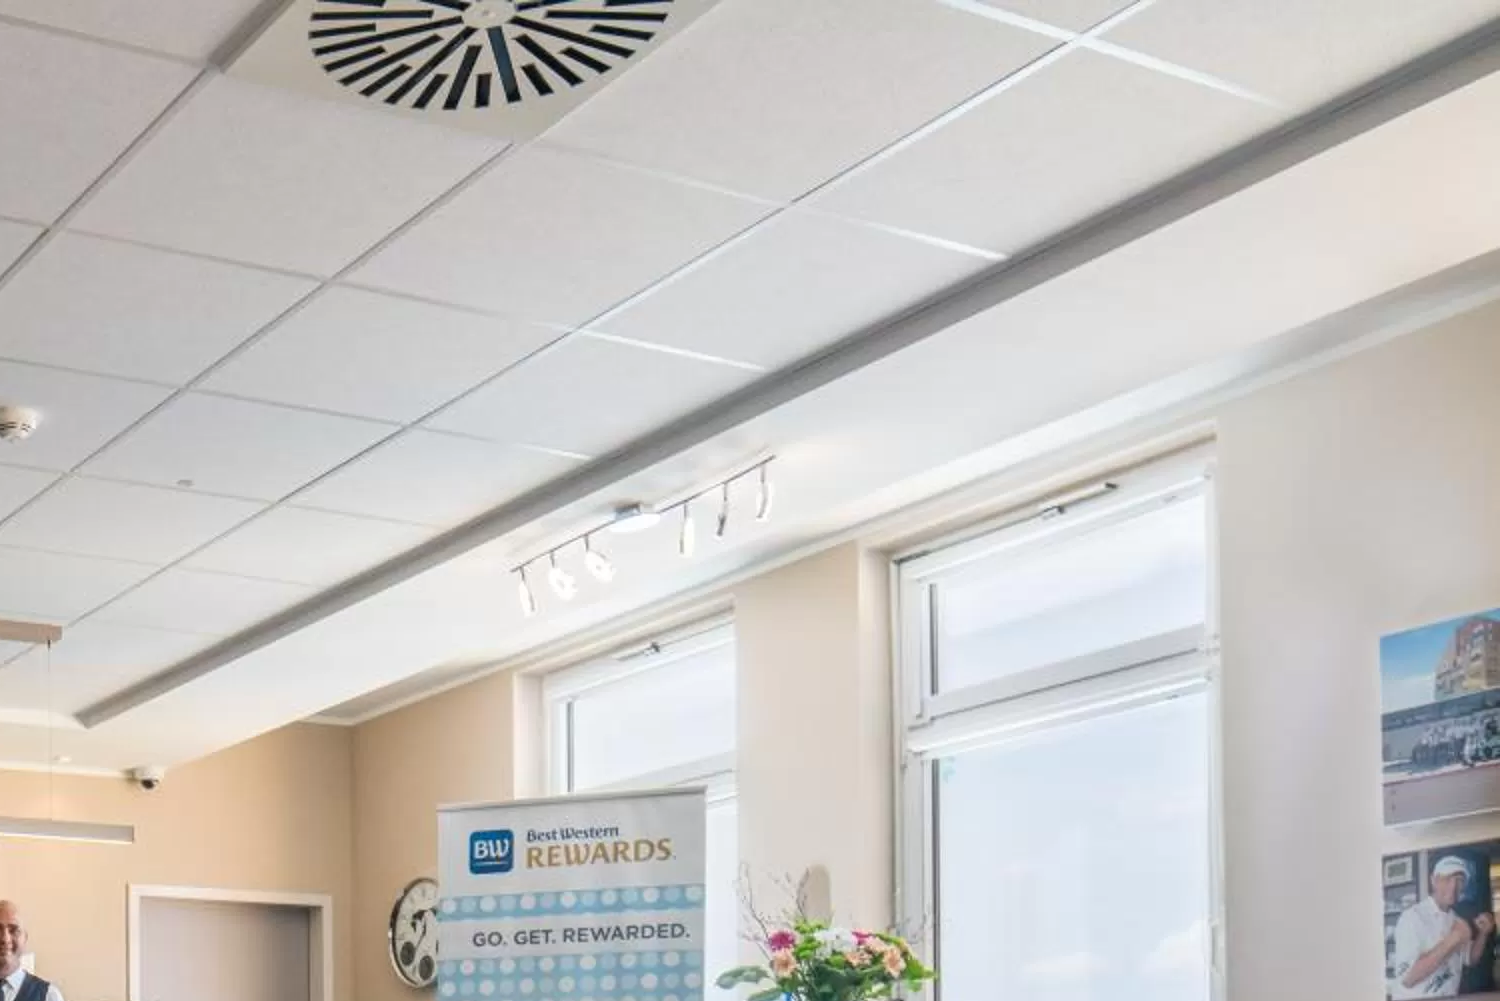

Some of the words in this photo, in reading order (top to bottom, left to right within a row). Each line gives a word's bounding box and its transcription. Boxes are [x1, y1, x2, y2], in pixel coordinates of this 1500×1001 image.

[526, 829, 557, 843] Best
[559, 826, 620, 841] Western
[473, 838, 511, 859] BW
[526, 838, 672, 869] REWARDS
[472, 931, 507, 947] GO.
[514, 929, 557, 945] GET.
[563, 923, 691, 943] REWARDED.
